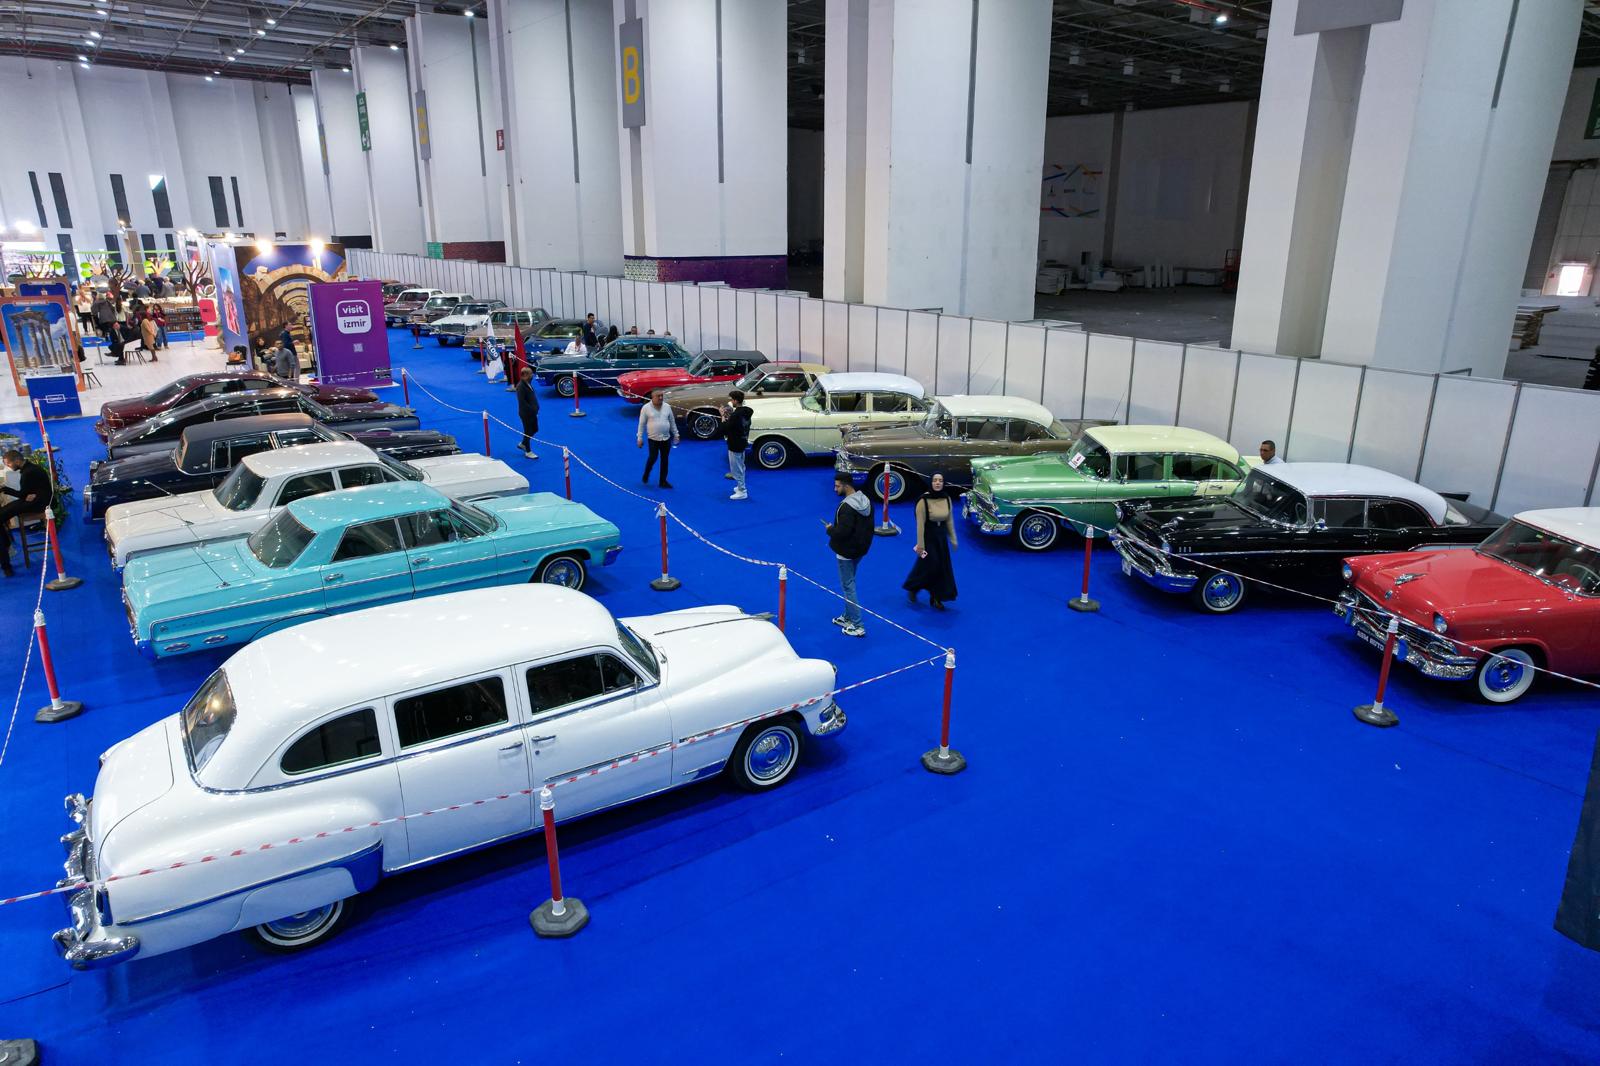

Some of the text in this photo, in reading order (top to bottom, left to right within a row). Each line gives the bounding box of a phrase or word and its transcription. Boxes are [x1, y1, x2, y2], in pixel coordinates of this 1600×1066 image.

[624, 47, 640, 104] B
[342, 305, 364, 314] visit
[343, 319, 367, 329] izmir
